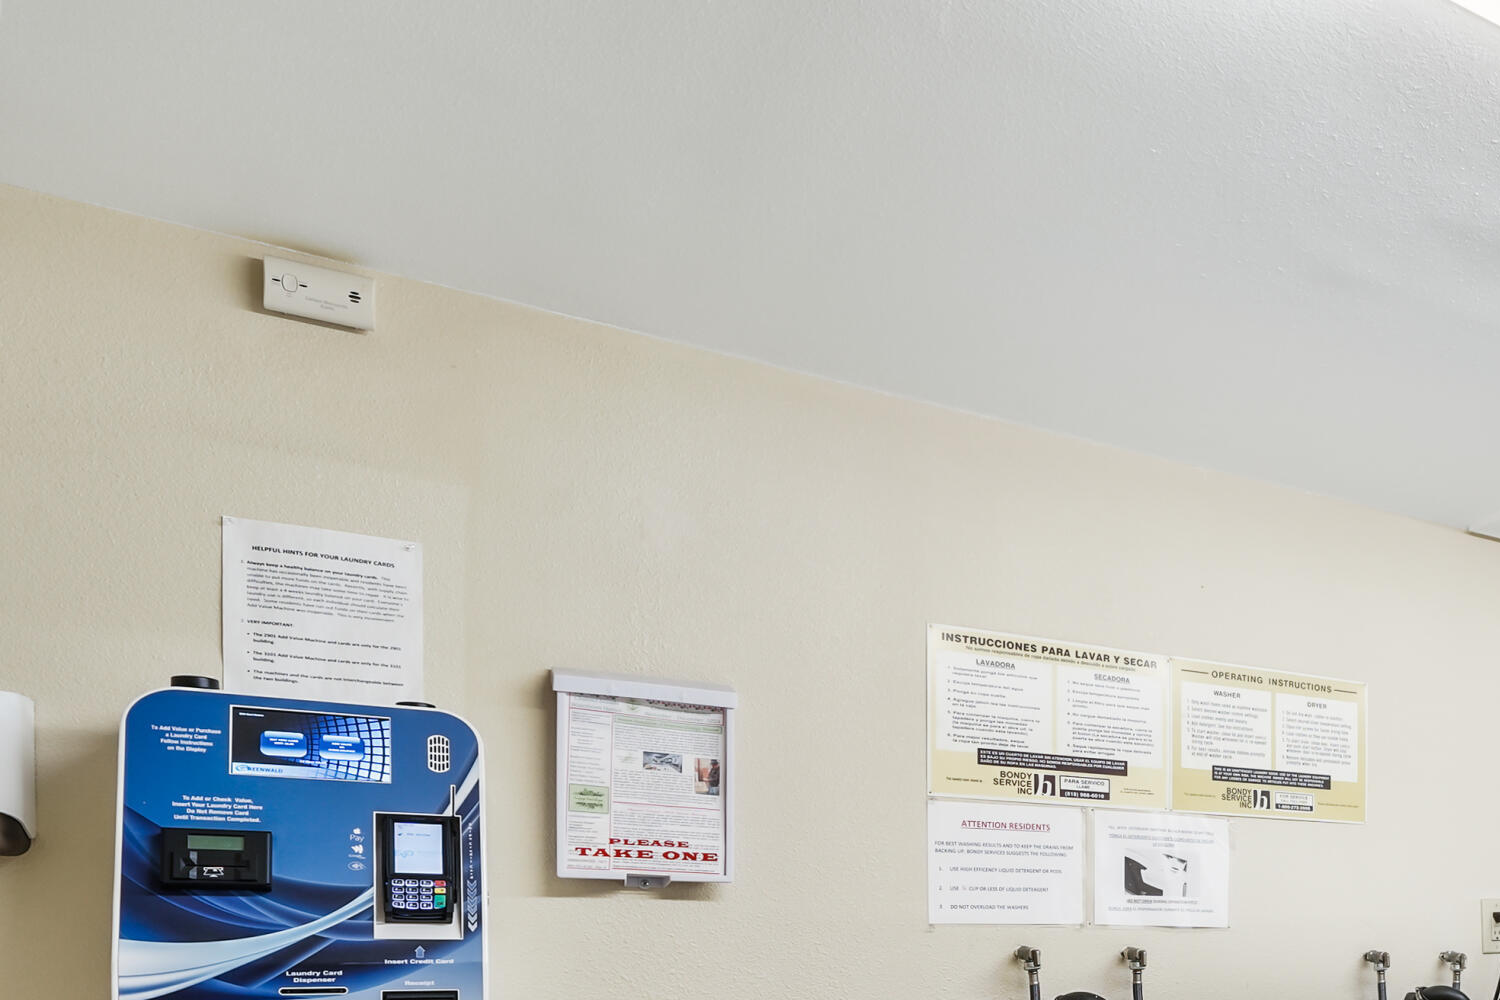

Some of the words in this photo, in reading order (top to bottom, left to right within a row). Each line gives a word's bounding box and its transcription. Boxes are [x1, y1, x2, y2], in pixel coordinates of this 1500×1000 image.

[252, 545, 281, 554] HELPFUL
[341, 555, 372, 565] LAUNDRY
[942, 632, 1037, 653] INSTRUCCIONES
[1041, 646, 1071, 657] PARA
[1075, 650, 1110, 662] LAVAR
[1124, 657, 1157, 669] SECAR
[976, 658, 1015, 670] LAVADORA
[1094, 673, 1130, 684] SECADORA
[1211, 670, 1263, 684] OPERATING
[1268, 678, 1332, 693] INSTRUCTIONS
[1213, 690, 1241, 699] WASHER
[1307, 701, 1327, 709] DRYER
[1000, 770, 1032, 780] BONDY
[993, 778, 1032, 788] SERVICE
[1017, 787, 1032, 795] INC
[961, 820, 1007, 829] ATTENTION
[1009, 823, 1050, 832] RESIDENTS
[350, 834, 364, 842] Pay
[609, 838, 690, 848] PLEASE
[575, 847, 654, 860] TAKE
[662, 851, 718, 862] ONE
